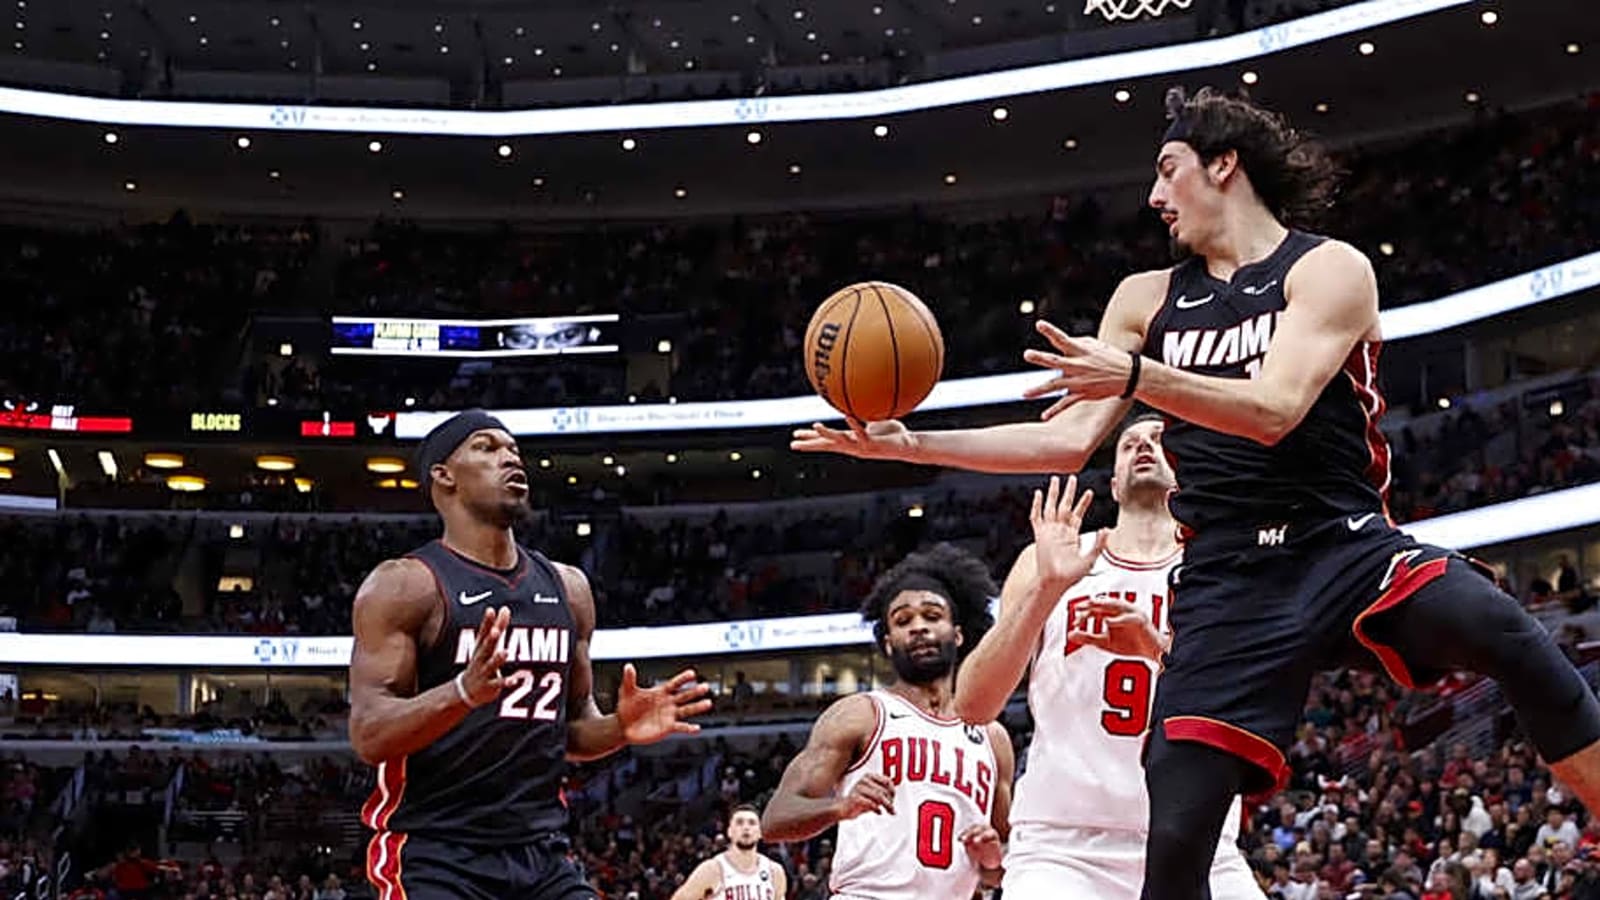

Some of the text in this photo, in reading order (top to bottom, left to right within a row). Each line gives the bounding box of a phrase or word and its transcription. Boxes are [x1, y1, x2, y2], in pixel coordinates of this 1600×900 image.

[1162, 312, 1286, 367] MIAM
[191, 413, 241, 431] BLOCKS
[499, 669, 562, 720] 22
[1101, 658, 1152, 737] 9
[881, 736, 992, 816] BULLS
[916, 799, 956, 870] 0
